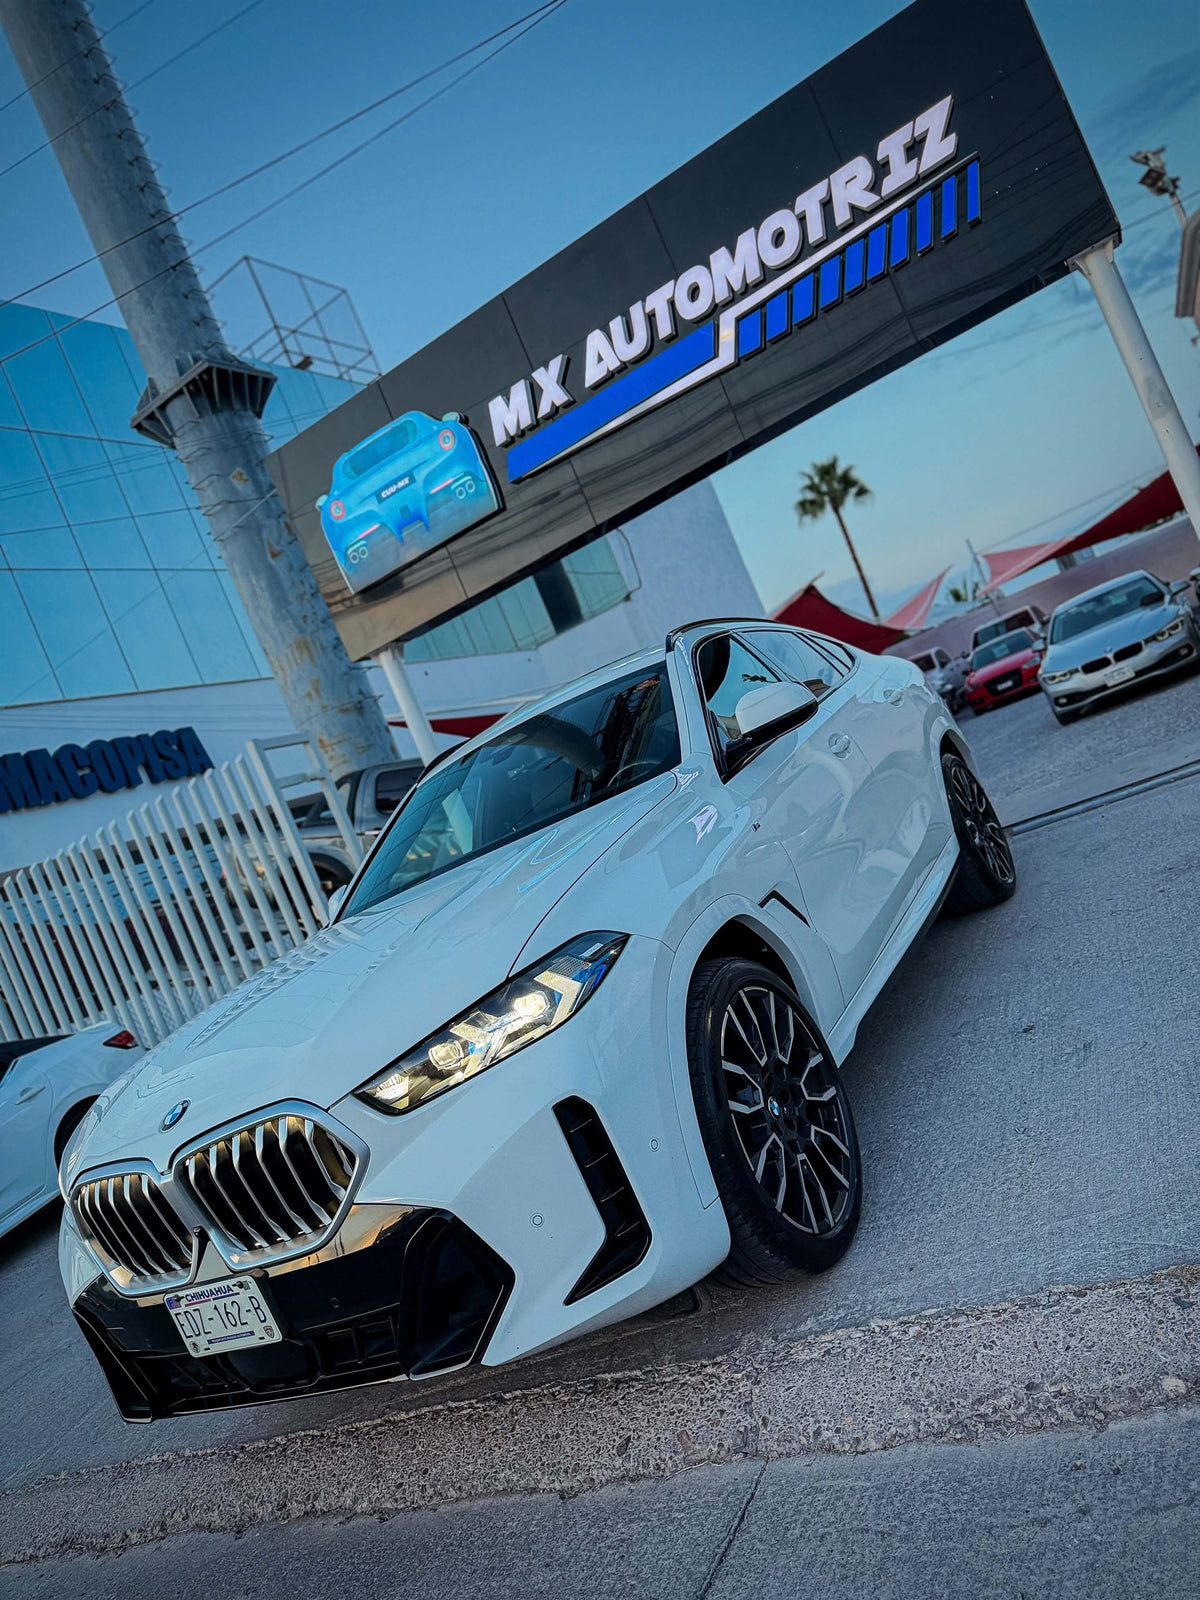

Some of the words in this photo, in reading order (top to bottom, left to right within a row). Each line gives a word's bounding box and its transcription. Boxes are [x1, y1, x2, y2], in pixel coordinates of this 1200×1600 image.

[488, 354, 573, 447] MX
[585, 94, 958, 389] AUTOMOTRIZ
[381, 477, 410, 499] CUU-MX
[0, 727, 214, 813] MACOPISA
[185, 1285, 234, 1302] CHIHUAHUA
[174, 1295, 267, 1339] EDZ-162-B
